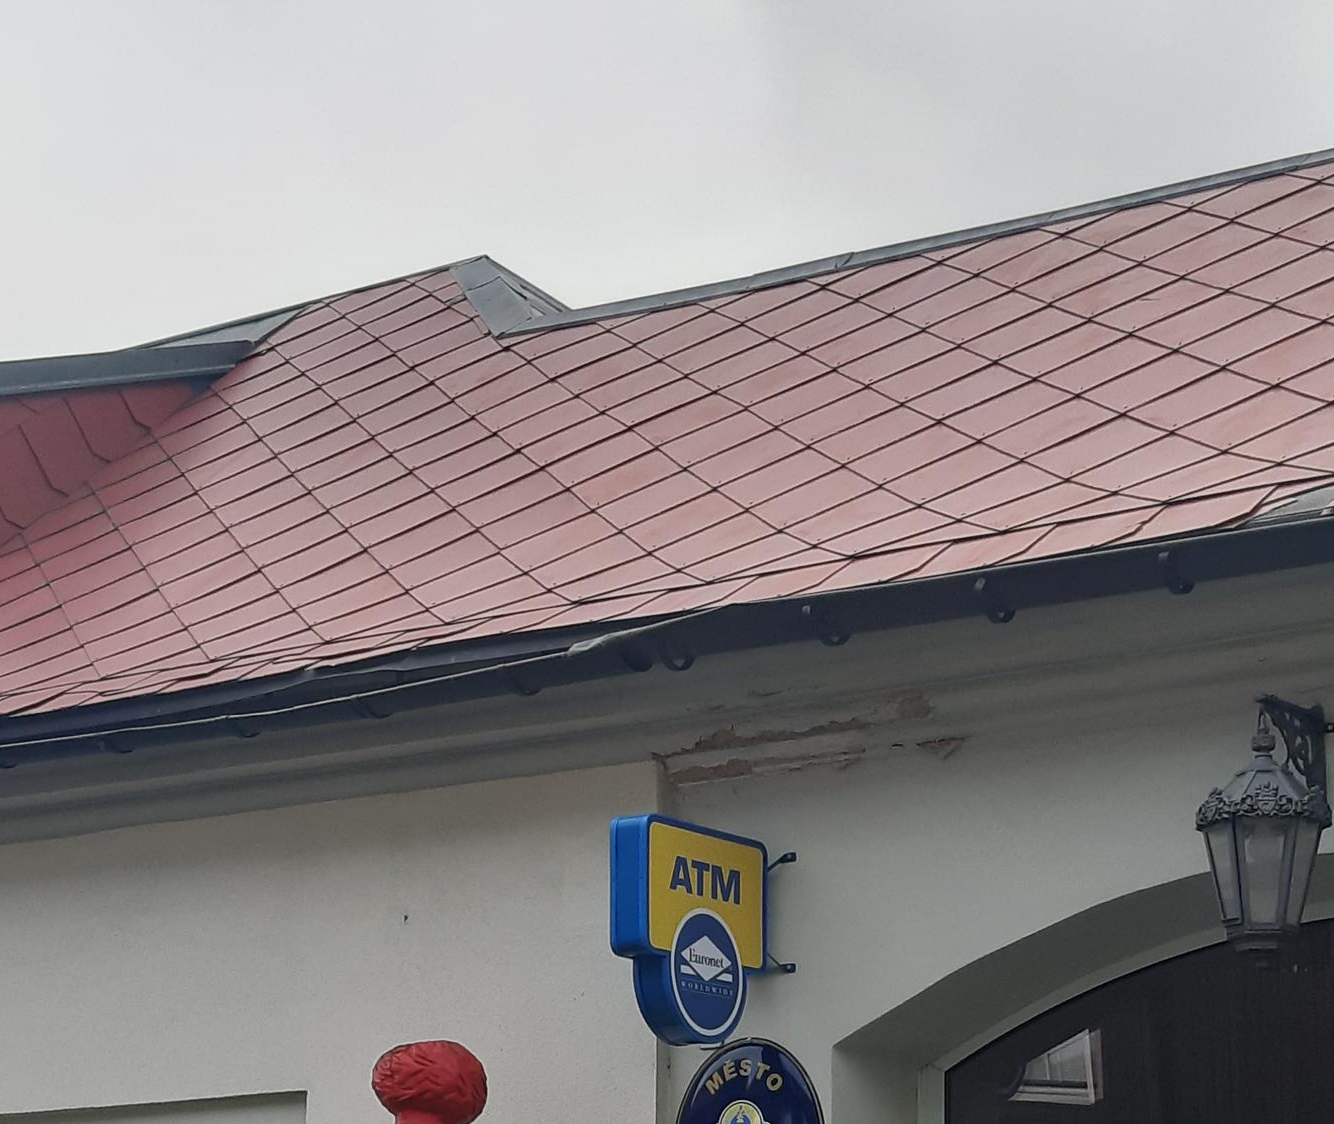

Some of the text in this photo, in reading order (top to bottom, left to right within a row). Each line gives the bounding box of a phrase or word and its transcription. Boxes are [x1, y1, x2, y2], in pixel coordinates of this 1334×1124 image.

[669, 856, 742, 905] ATM
[689, 947, 725, 969] Euronet
[705, 1058, 784, 1096] MĚSTO
